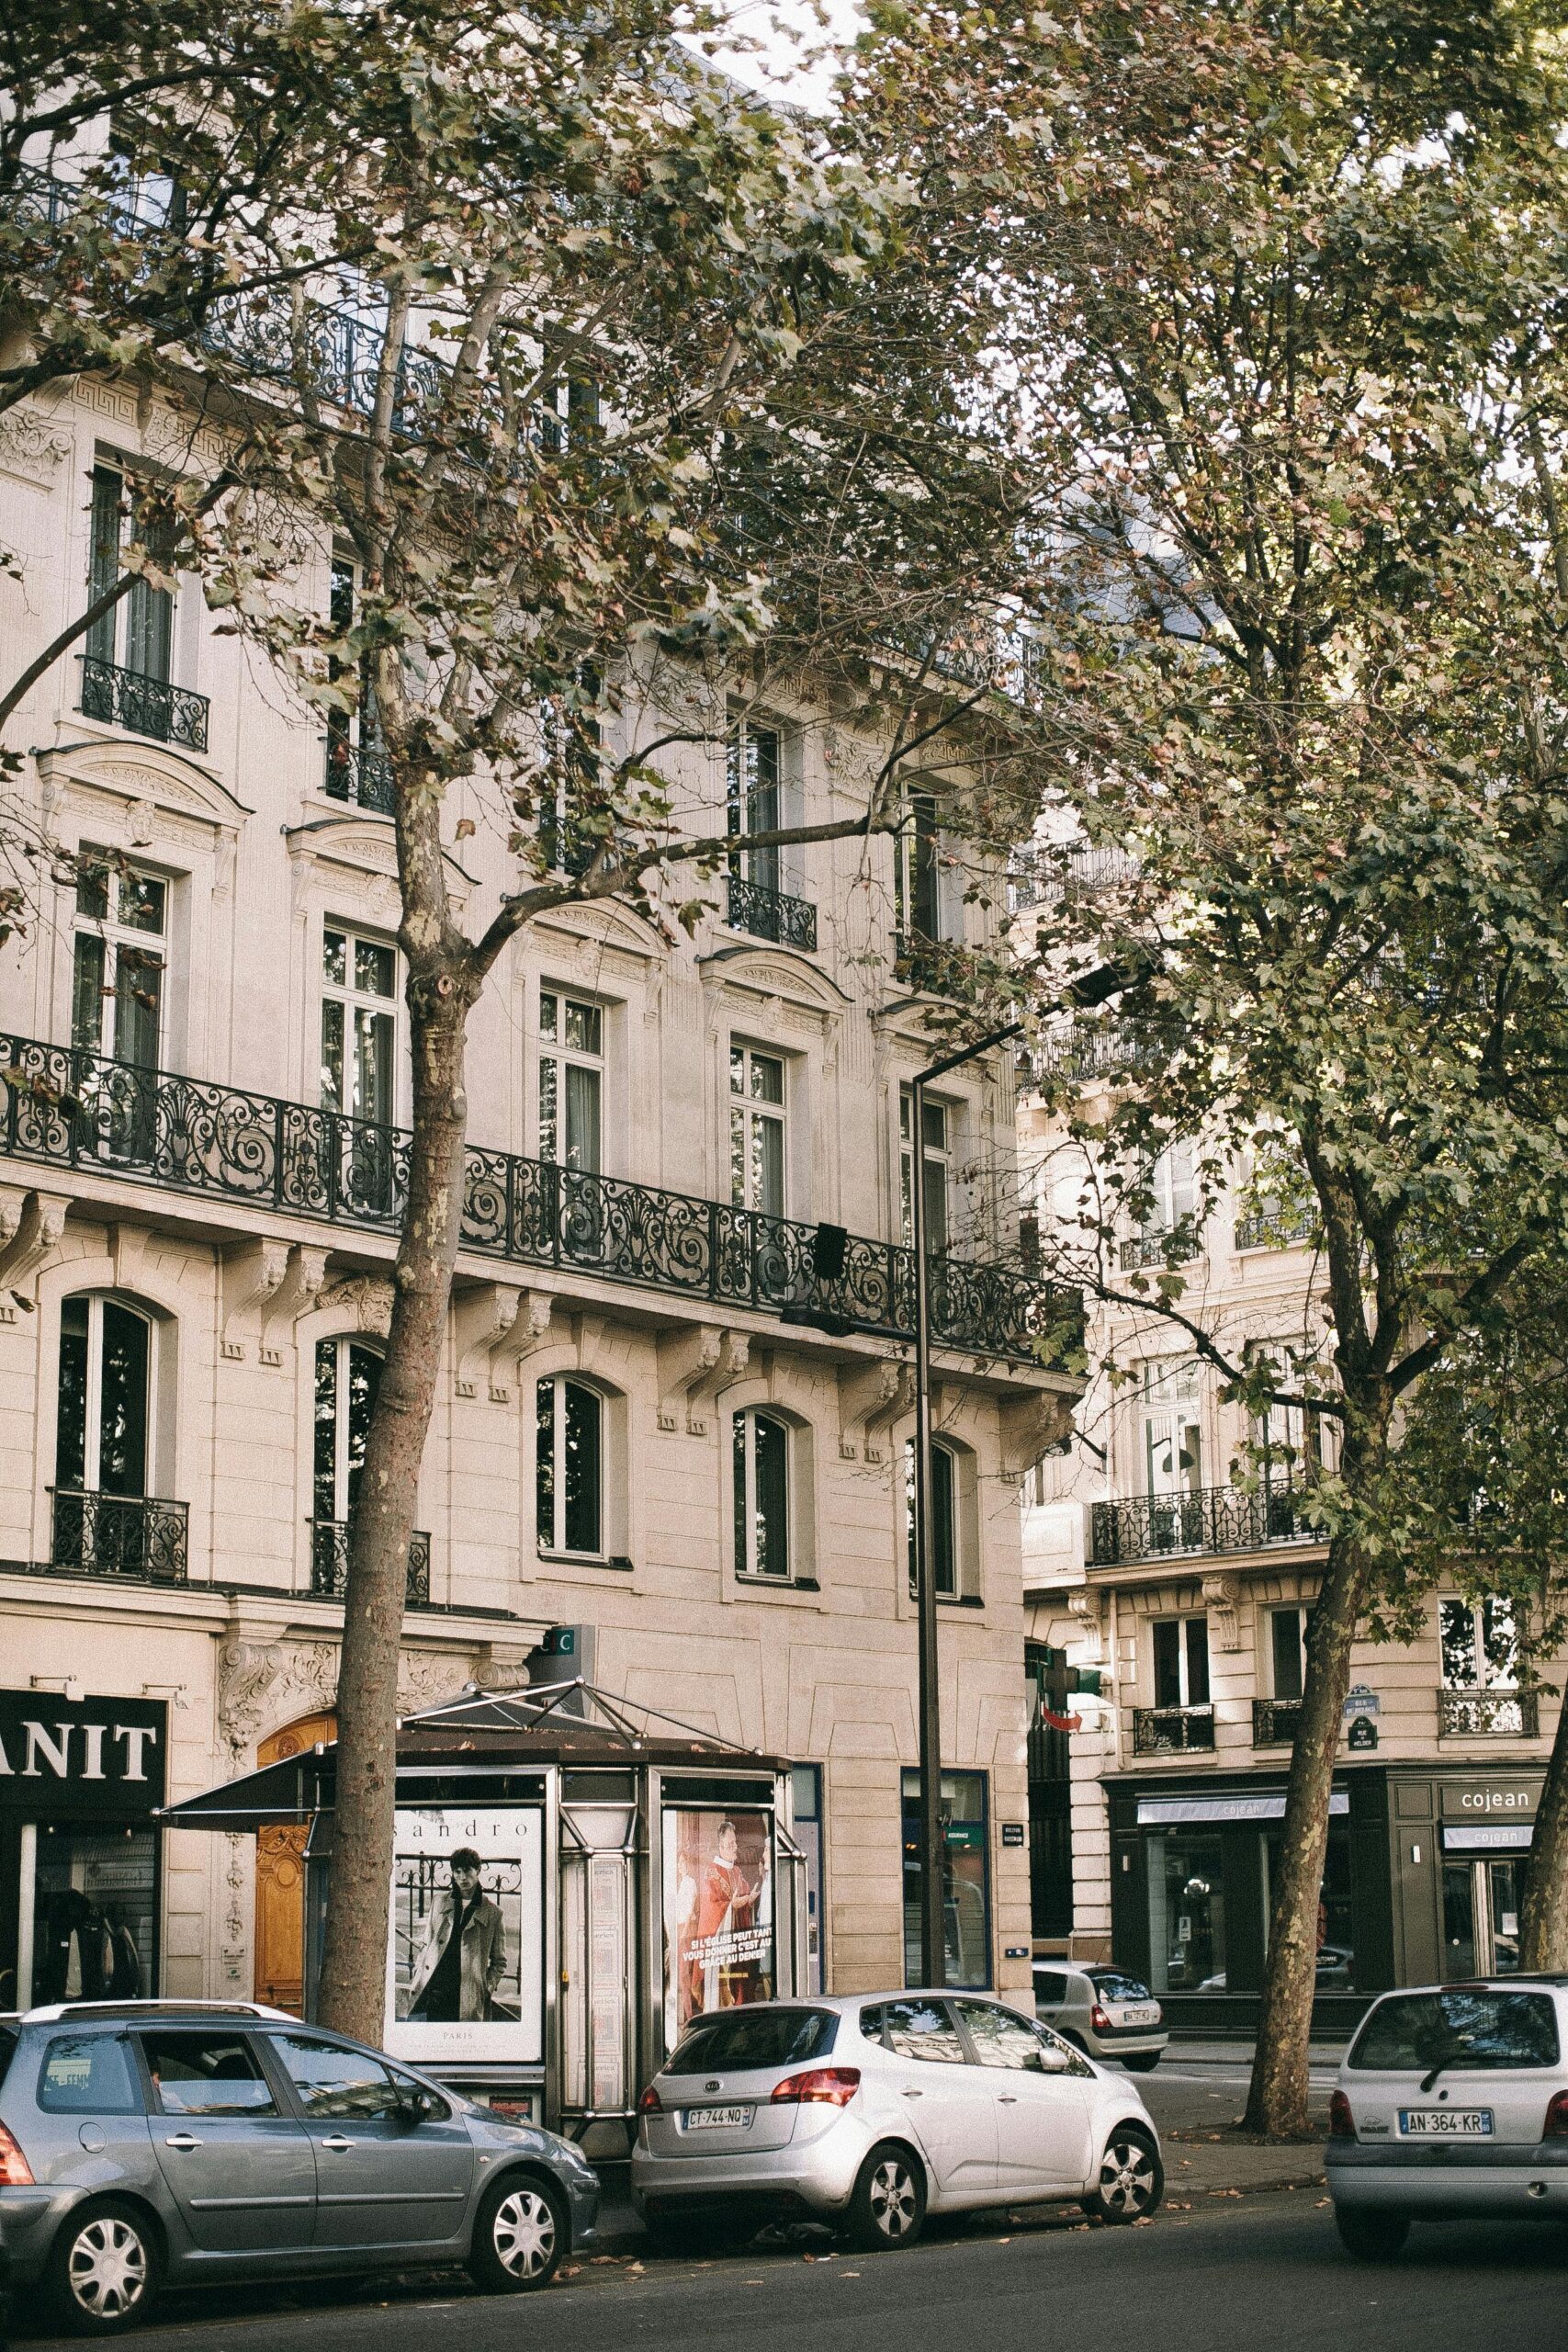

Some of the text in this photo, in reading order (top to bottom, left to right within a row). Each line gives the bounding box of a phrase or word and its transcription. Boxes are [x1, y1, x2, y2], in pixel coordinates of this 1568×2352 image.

[1461, 1789, 1529, 1813] cojean
[1224, 1804, 1259, 1817] cojean
[1474, 1832, 1517, 1845] cojean
[691, 1927, 772, 1950] SI L'ÉGLISE PEUT TANT
[682, 1937, 772, 1962] VOUS DONNER C'EST AU
[726, 1954, 738, 1964] AU
[739, 1949, 766, 1962] DENIER
[1409, 2114, 1481, 2132] AN-364-KR
